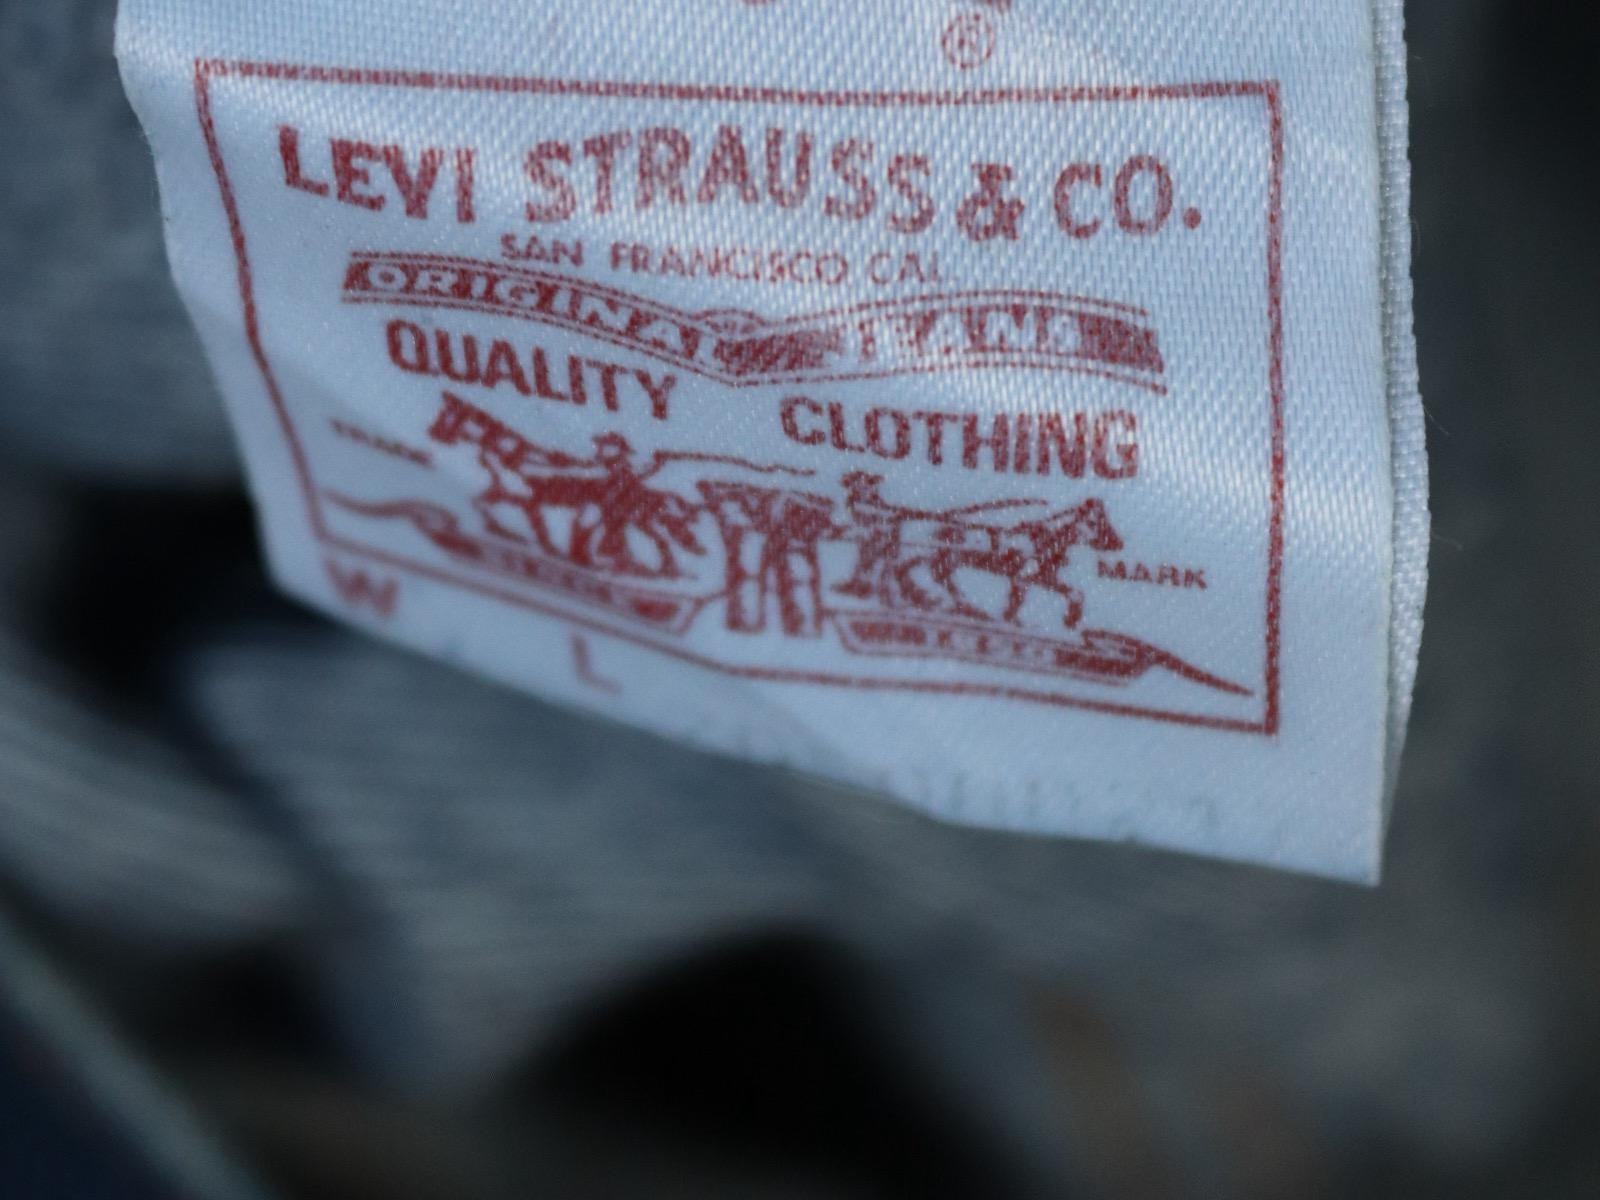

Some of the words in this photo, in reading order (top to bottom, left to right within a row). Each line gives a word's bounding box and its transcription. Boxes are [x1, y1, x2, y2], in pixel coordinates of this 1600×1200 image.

[278, 124, 476, 223] LEVI
[523, 124, 936, 235] STRAUSS
[956, 163, 1025, 242] &
[1053, 154, 1202, 239] CO.
[501, 233, 584, 268] SAN
[611, 240, 848, 286] FRANCISCO
[386, 318, 677, 420] QUALITY
[780, 397, 1140, 480] CLOTHING
[325, 557, 398, 618] W
[1097, 558, 1208, 590] MARK
